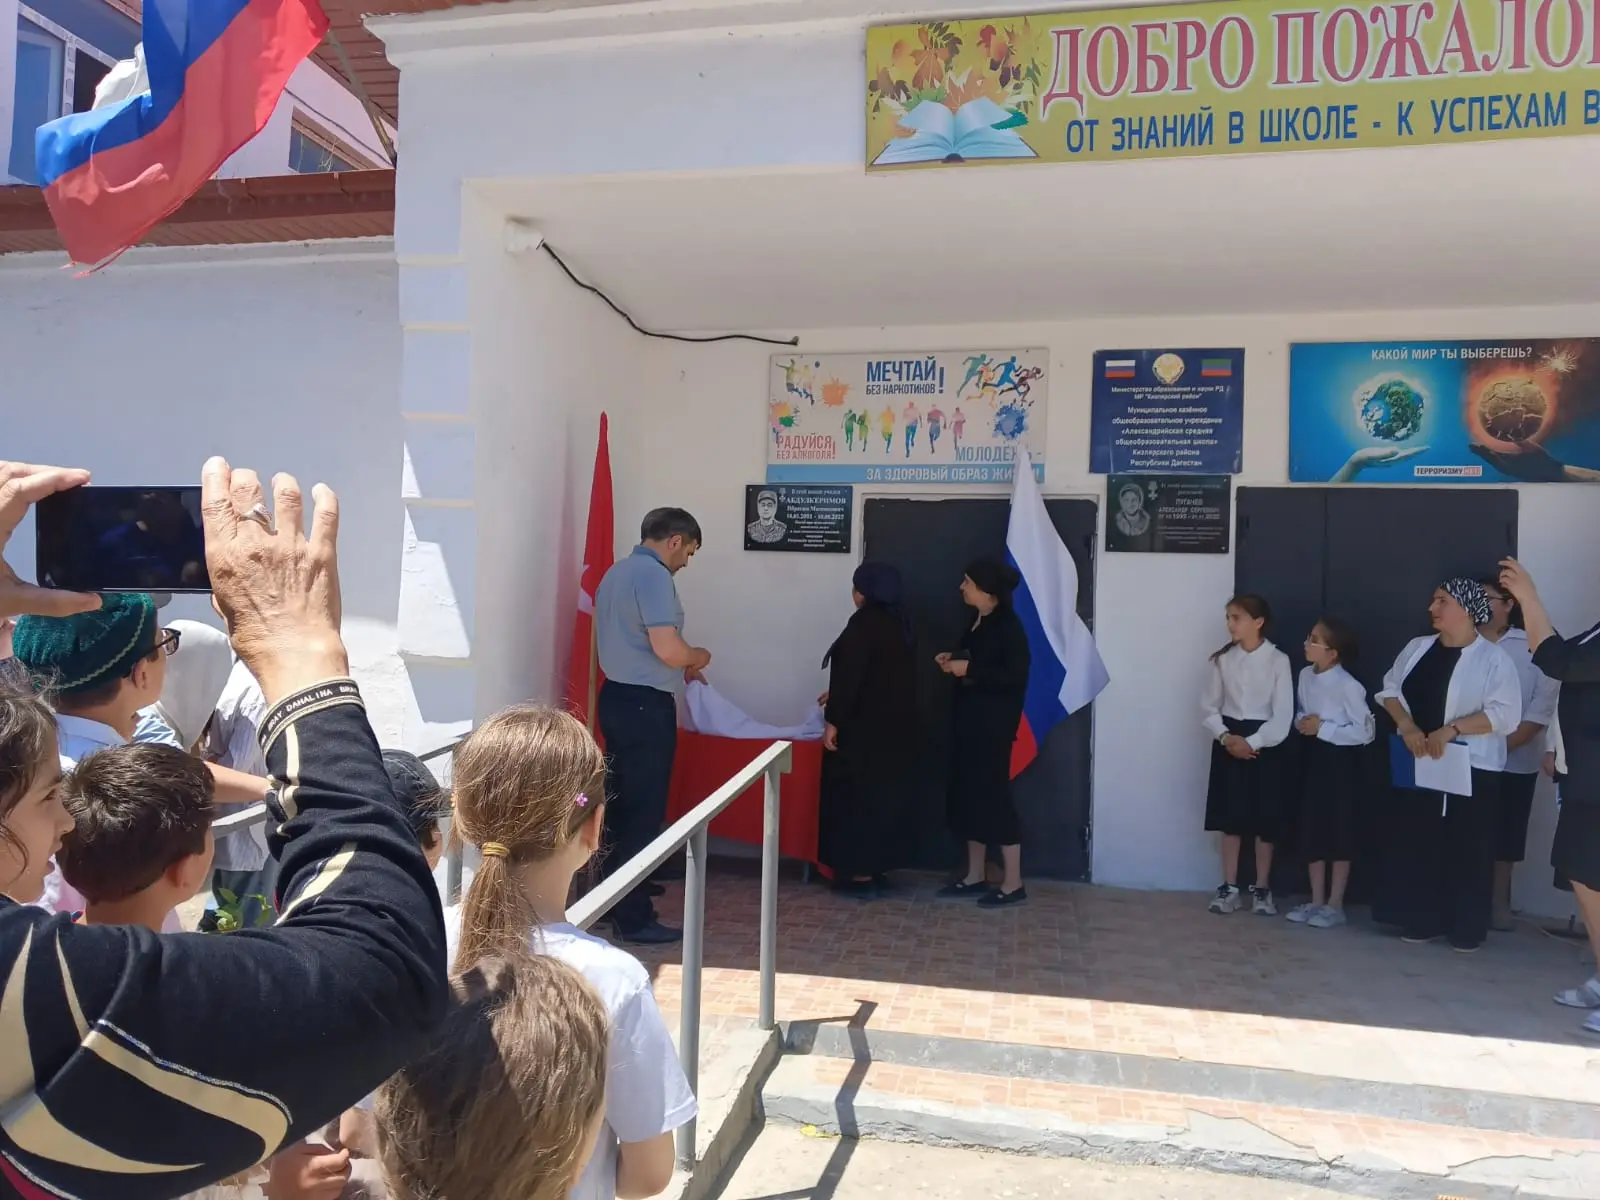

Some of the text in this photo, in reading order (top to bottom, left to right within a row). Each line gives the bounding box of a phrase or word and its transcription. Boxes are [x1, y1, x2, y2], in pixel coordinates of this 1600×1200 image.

[1042, 0, 1600, 118] ДОБРО ПОЖАЛО
[1066, 119, 1099, 153] ОТ
[1111, 106, 1213, 151] ЗНАНИЙ
[1228, 111, 1244, 145] В
[1259, 104, 1358, 144] ШКОЛЕ
[1373, 121, 1381, 129] -
[1397, 101, 1414, 136] К
[1431, 91, 1567, 135] УСПЕХАМ
[1371, 346, 1533, 360] КАКОЙ МИР ТЫ ВЫБЕРЕШЬ?
[866, 383, 936, 395] БЕЗ НАРКОТИКОВ
[1128, 406, 1177, 414] Муниципальное
[1112, 417, 1183, 425] общеобразовательное
[1116, 438, 1190, 446] общеобразовательная
[776, 450, 832, 460] БЕЗ АЛКОГОЛЯ
[1132, 448, 1200, 456] Кизлярского района
[1130, 459, 1202, 467] Республики Дагестан
[866, 468, 880, 481] ЗА
[884, 465, 948, 482] ЗДОРОВЫЙ
[951, 467, 988, 481] ОБРАЗ
[1416, 467, 1463, 475] ТЕРРОРИЗМУ
